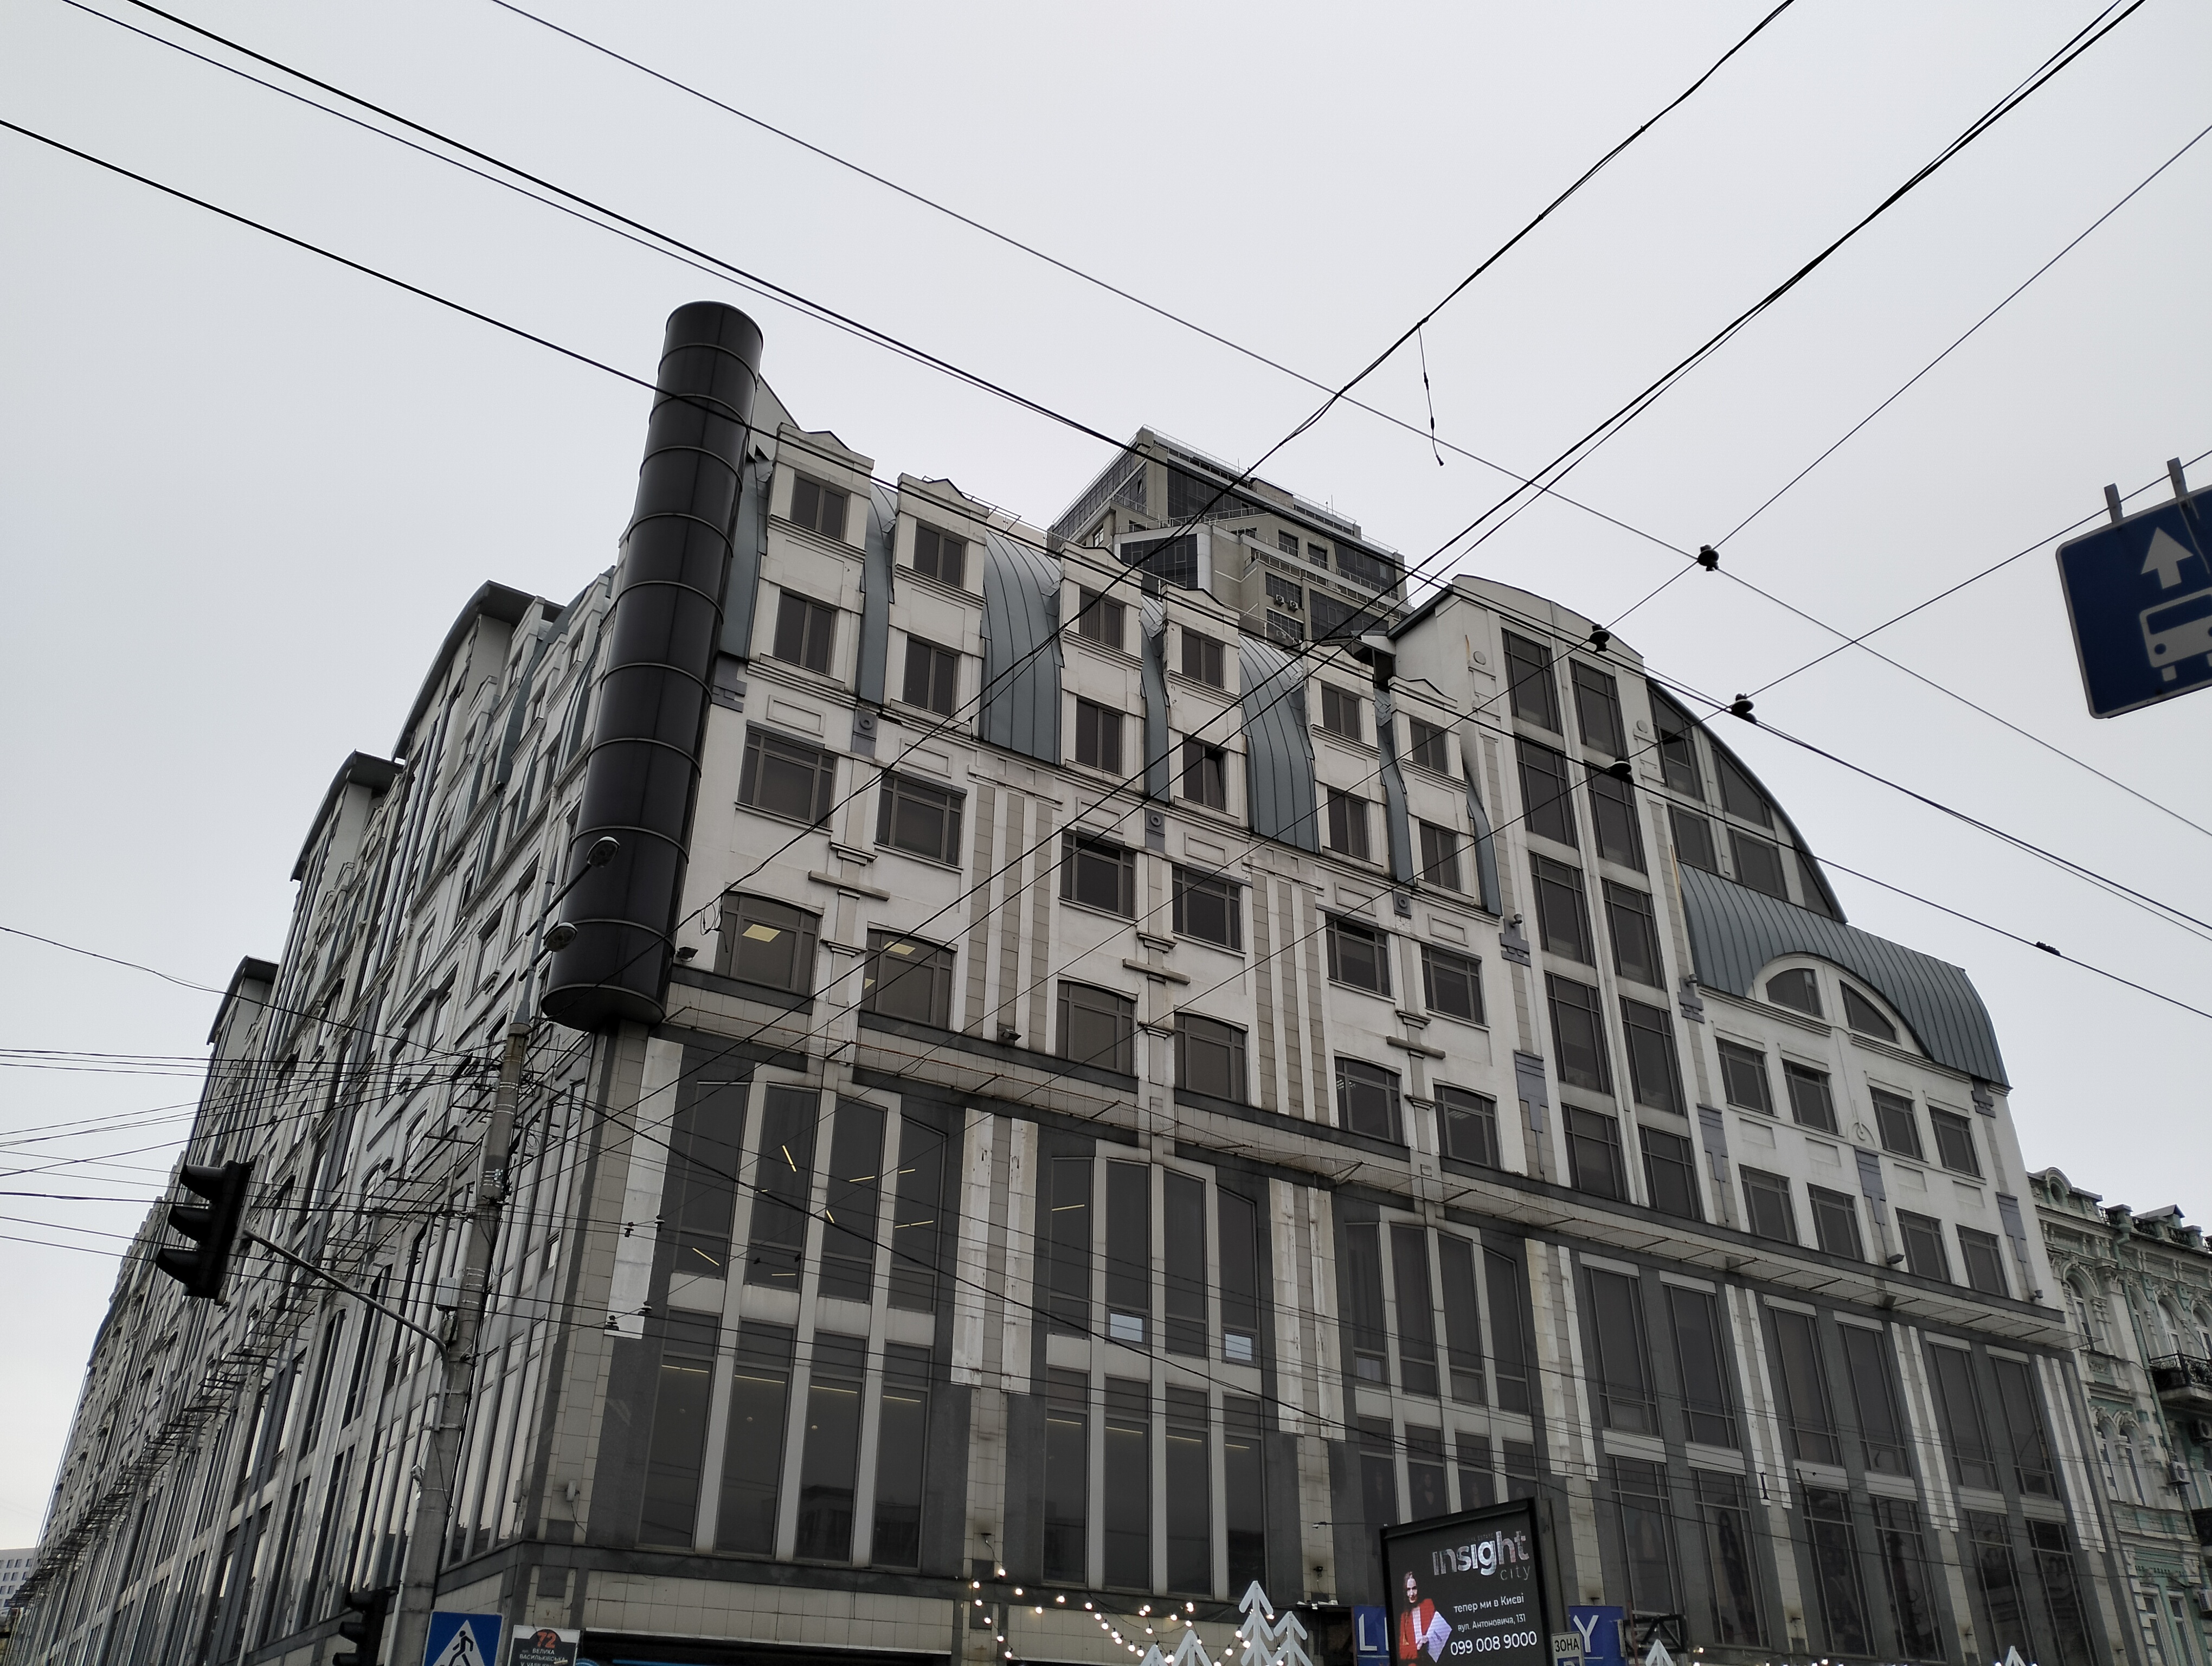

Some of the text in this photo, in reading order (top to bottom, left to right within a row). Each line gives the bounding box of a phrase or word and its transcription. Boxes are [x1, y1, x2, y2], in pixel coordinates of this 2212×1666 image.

[1432, 1530, 1529, 1575] insight
[1500, 1565, 1531, 1580] city
[1454, 1603, 1478, 1613] тепер
[1480, 1600, 1491, 1609] ми
[1500, 1592, 1524, 1606] Києві
[1359, 1613, 1389, 1651] L
[1458, 1613, 1526, 1632] вул. Антоновича, 131
[537, 1631, 556, 1648] 72
[1450, 1631, 1538, 1655] 099 008 9000
[1554, 1638, 1580, 1652] ЗОНА
